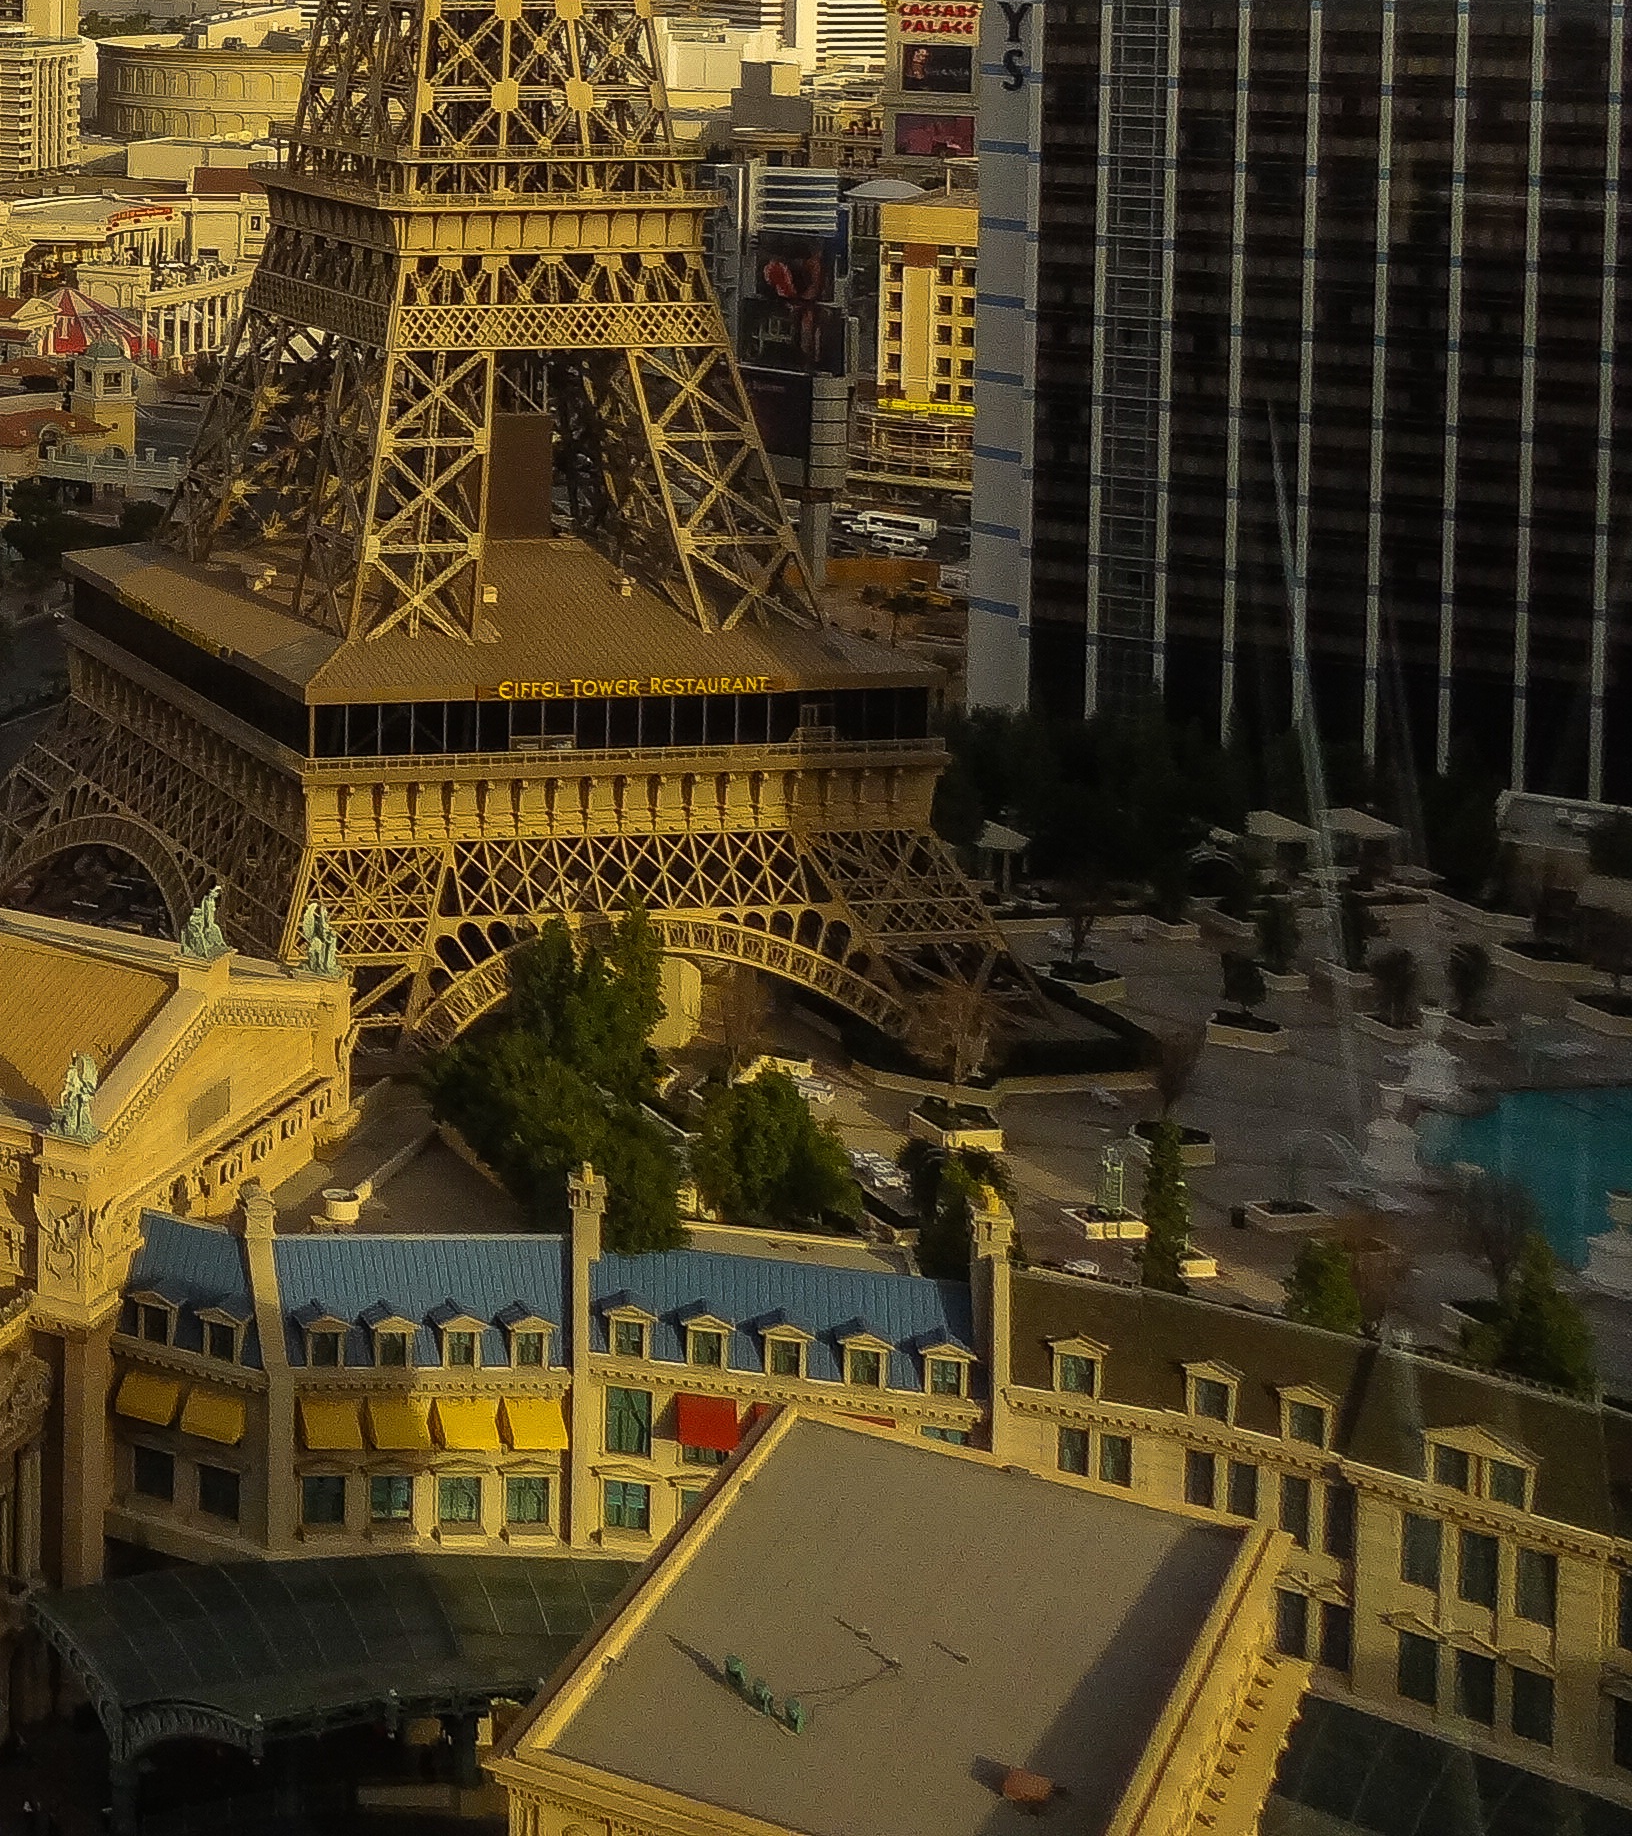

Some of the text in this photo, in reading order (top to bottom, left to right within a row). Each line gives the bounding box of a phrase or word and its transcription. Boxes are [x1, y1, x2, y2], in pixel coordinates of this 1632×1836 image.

[898, 3, 978, 17] CAESARS
[901, 20, 974, 33] PALACE
[498, 676, 769, 700] EIFFEL TOWER RESTAURANT
